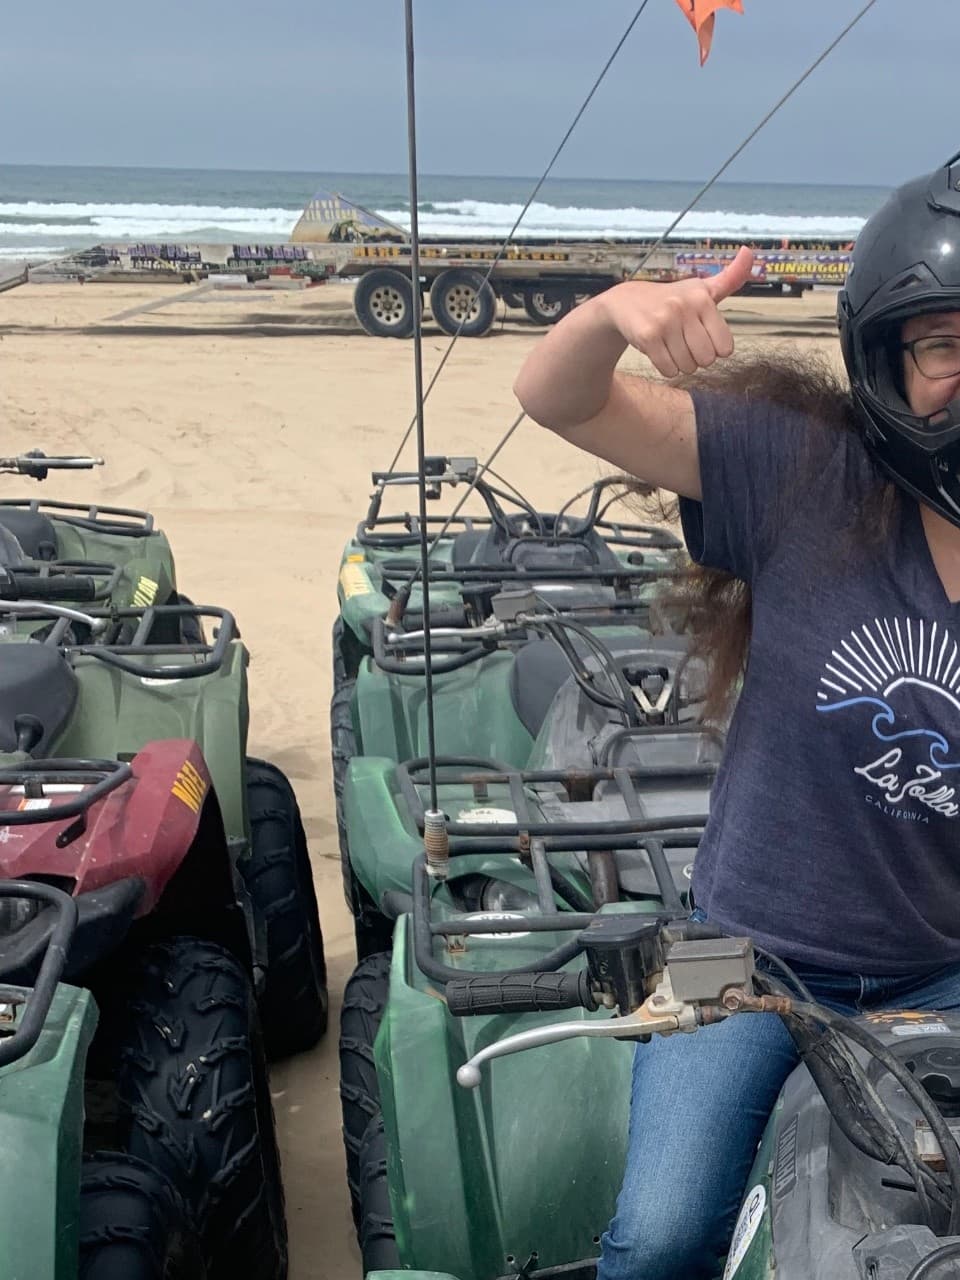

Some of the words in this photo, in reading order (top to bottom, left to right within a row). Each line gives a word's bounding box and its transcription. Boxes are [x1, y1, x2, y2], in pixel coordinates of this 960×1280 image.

[854, 747, 902, 791] La
[885, 764, 959, 817] Jolla
[775, 1117, 799, 1195] YAMAHA
